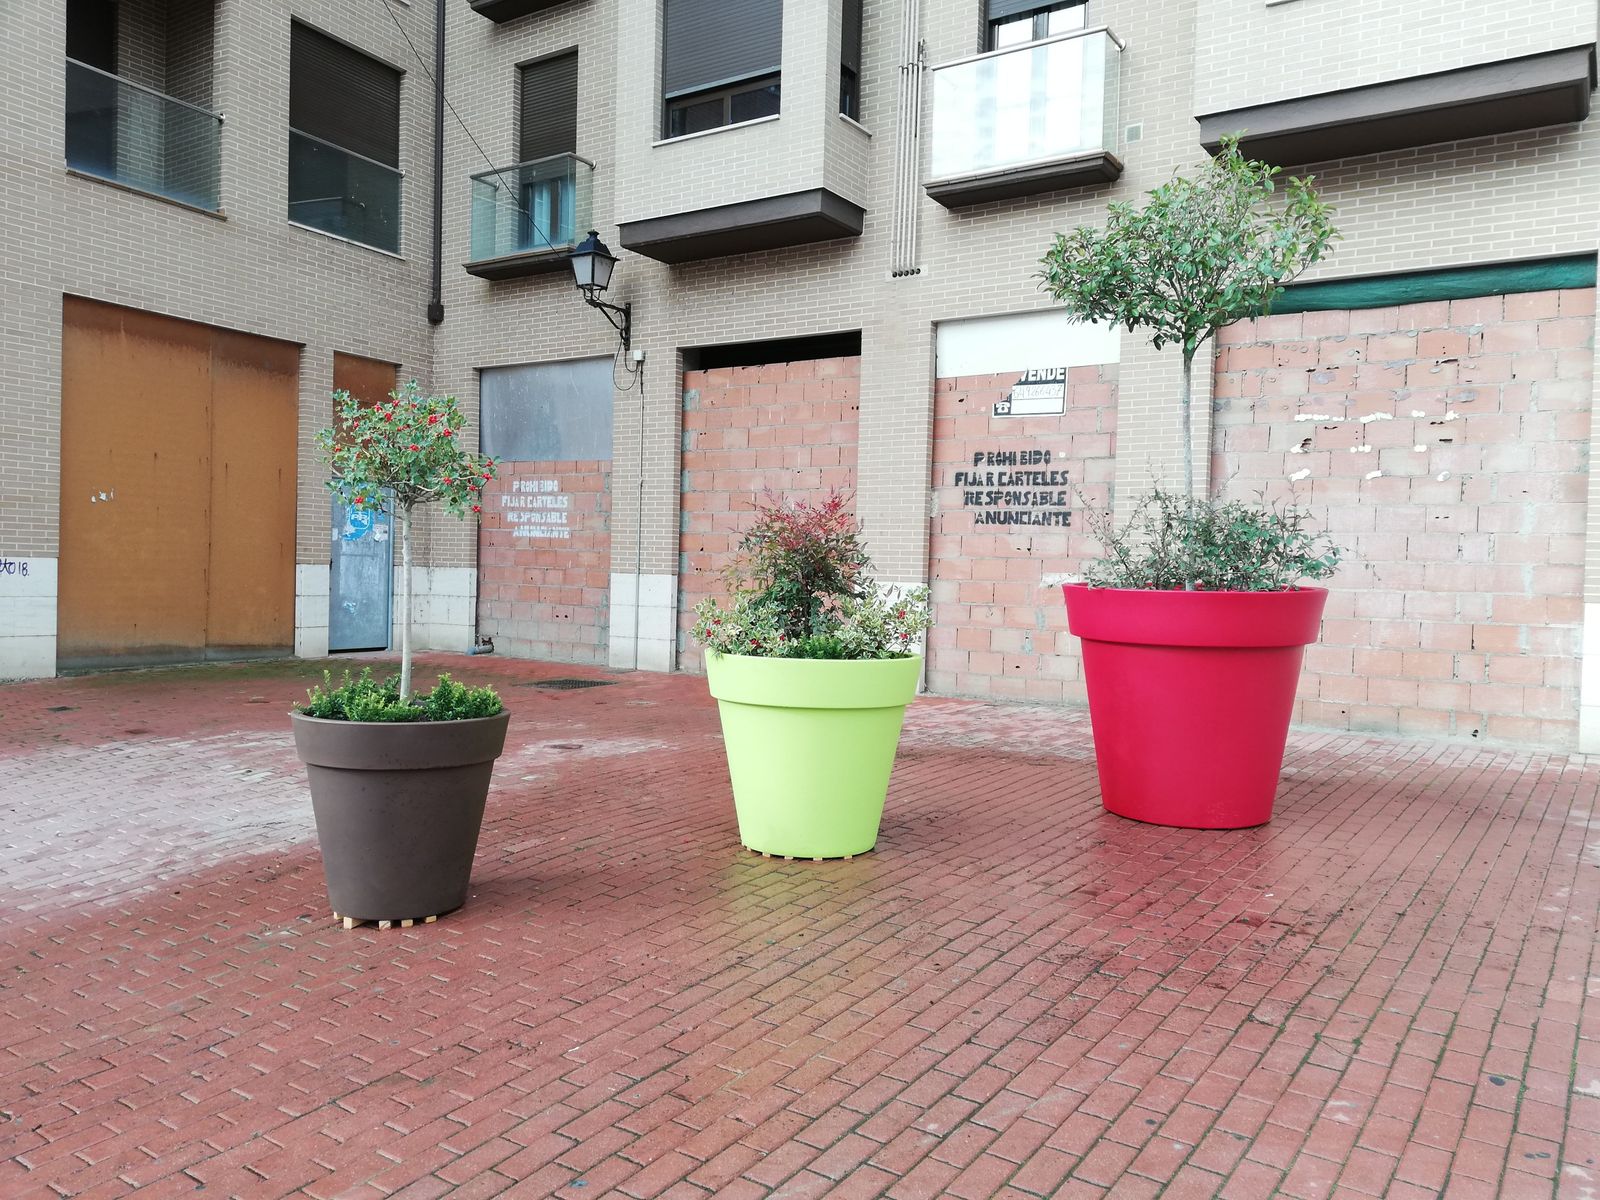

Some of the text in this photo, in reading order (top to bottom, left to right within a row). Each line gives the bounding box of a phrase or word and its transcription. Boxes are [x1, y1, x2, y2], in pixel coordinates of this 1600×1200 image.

[973, 450, 1051, 466] PROHIBIDO
[513, 480, 558, 492] PROHIBIDO
[955, 471, 1069, 487] FIJAR CARTELES
[502, 495, 568, 508] FIJAR CARTELES
[963, 490, 1067, 506] RESPONSABLE
[507, 512, 567, 523] RESPONSABLE
[975, 510, 1072, 527] ANUNCIANTE
